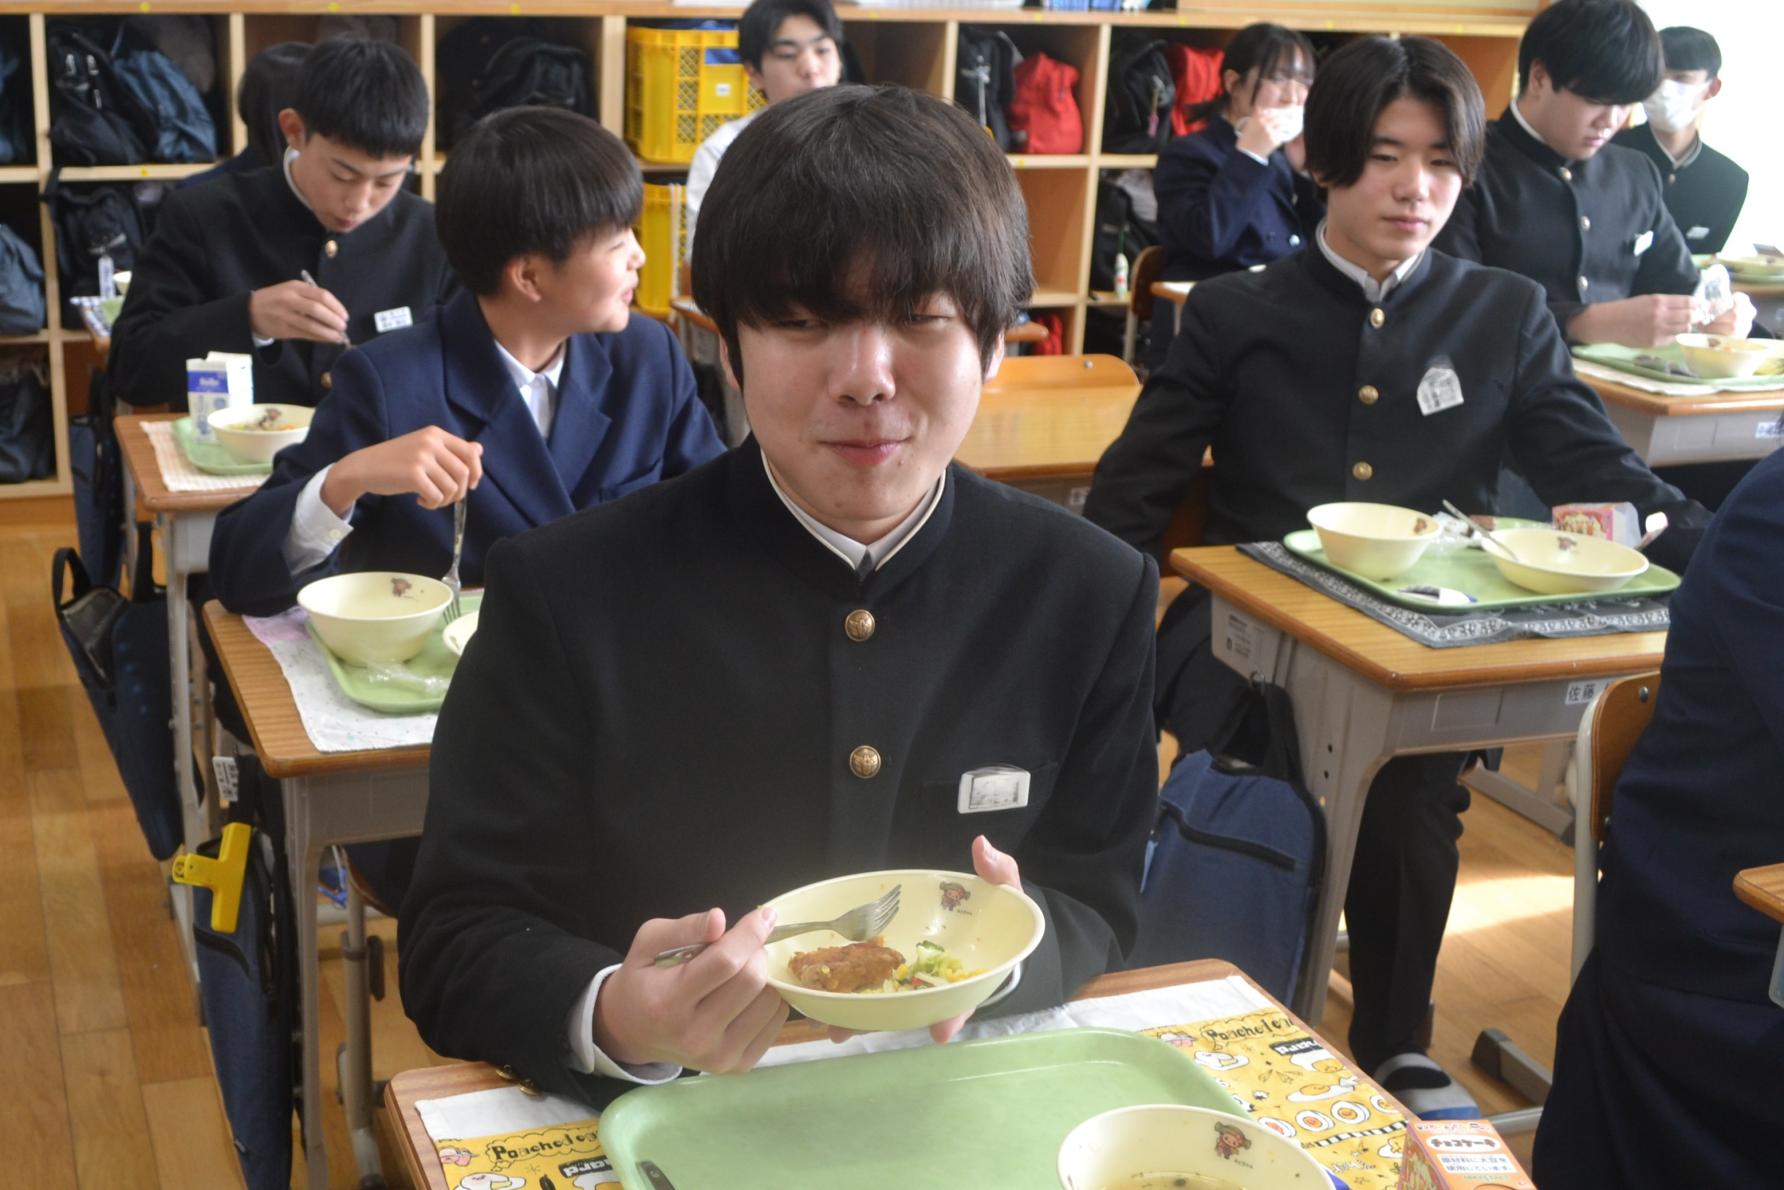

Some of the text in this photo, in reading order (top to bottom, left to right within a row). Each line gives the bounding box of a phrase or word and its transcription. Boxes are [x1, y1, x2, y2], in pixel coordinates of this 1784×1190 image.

[1430, 1138, 1496, 1149] チョコケーキ
